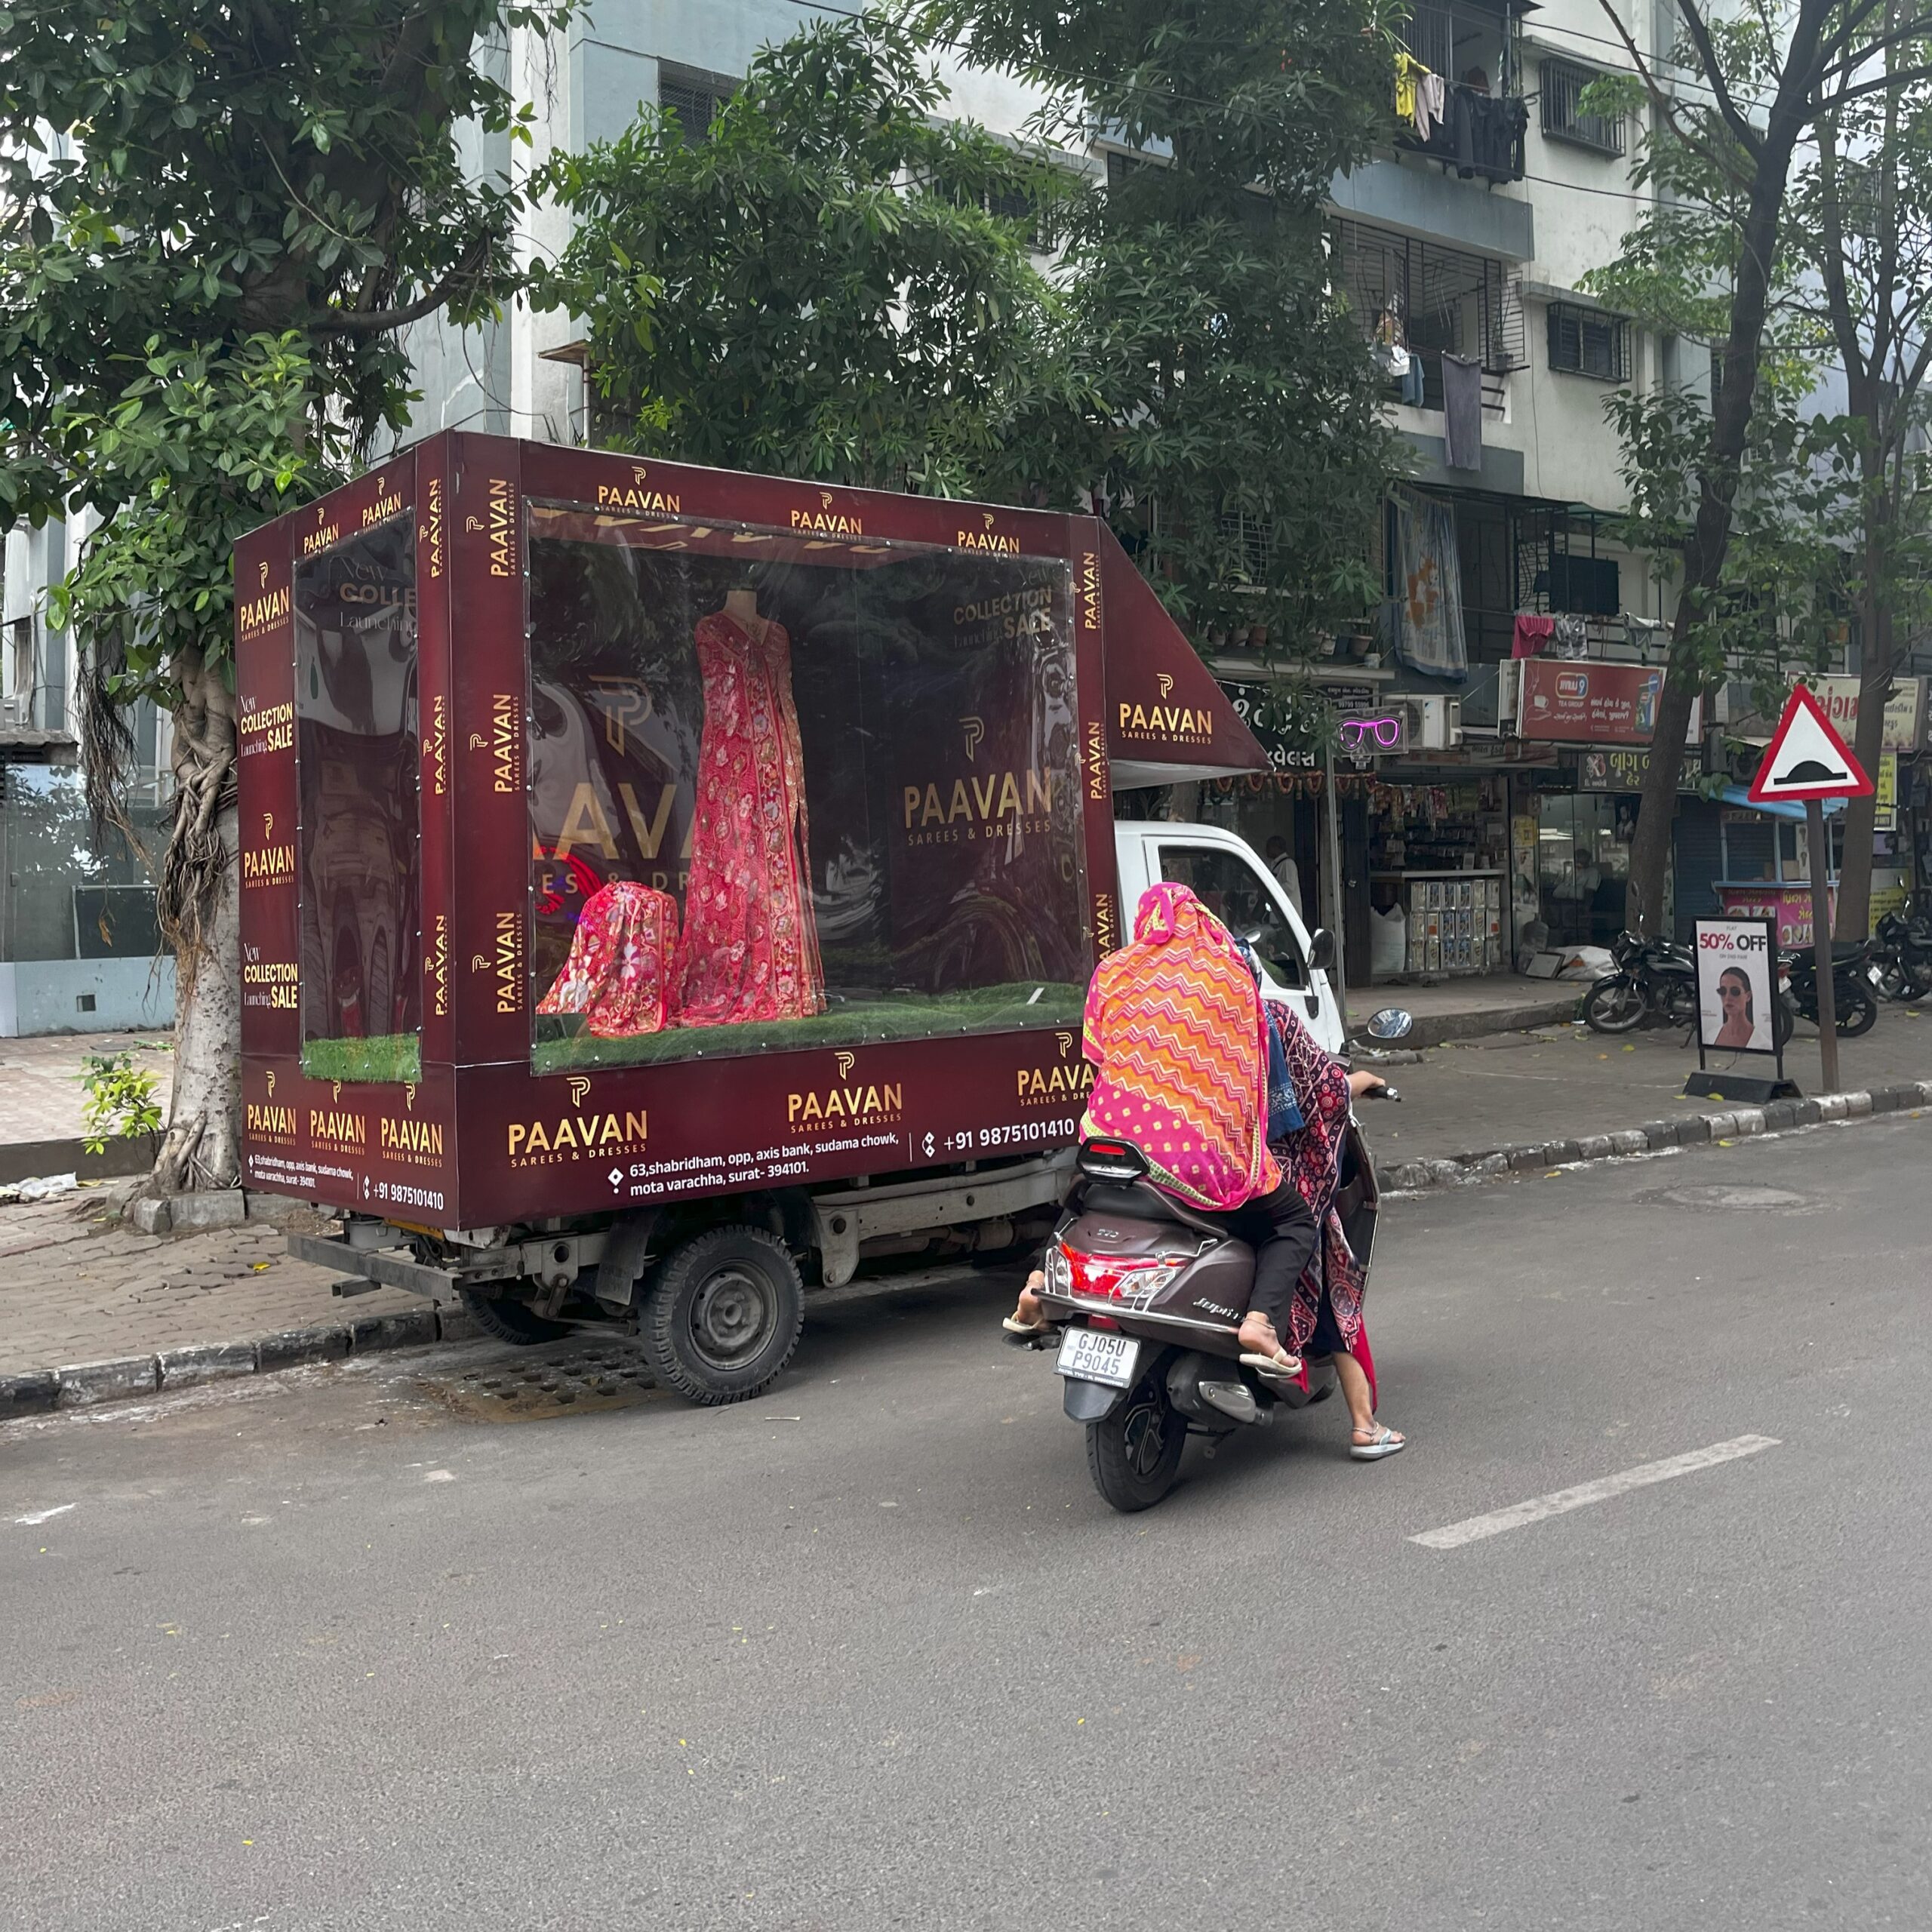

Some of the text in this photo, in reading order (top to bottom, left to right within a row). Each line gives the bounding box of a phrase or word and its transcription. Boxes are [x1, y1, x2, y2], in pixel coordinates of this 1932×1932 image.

[362, 492, 401, 527] PAAVAN
[598, 485, 679, 512] PAAVAN
[304, 522, 339, 554] PAAVAN
[429, 479, 439, 578] PAAVAN
[489, 479, 509, 577] PAAVAN
[791, 510, 862, 534] PAAVAN
[958, 531, 1019, 553] PAAVAN
[954, 585, 1052, 625] COLLECTION
[1083, 552, 1096, 629] PAAVAN
[241, 586, 289, 632] PAAVAN
[1559, 680, 1584, 694] JIVRAJ 9
[242, 701, 293, 734] COLLECTION
[1120, 703, 1212, 735] PAAVAN
[267, 724, 293, 752] SALE
[434, 696, 443, 795] PAAVAN
[494, 694, 512, 792] PAAVAN
[1122, 731, 1156, 740] SAREES
[1173, 734, 1211, 745] DRESSES
[1088, 721, 1102, 799] PAAVAN
[904, 767, 1051, 829] PAAVAN
[908, 820, 1051, 846] SAREES & DRESSES
[245, 844, 294, 878] PAAVAN
[1700, 933, 1766, 951] 50% OFF
[245, 964, 297, 983] COLLECTION
[436, 915, 445, 1015] PAAVAN
[497, 913, 515, 1013] PAAVAN
[271, 986, 297, 1008] SALE
[1017, 1063, 1095, 1096] PAAVA
[788, 1083, 903, 1122] PAAVAN
[1020, 1095, 1055, 1106] SAREES
[1073, 1091, 1090, 1100] DRE
[248, 1104, 296, 1134] PAAVAN
[310, 1109, 365, 1144] PAAVAN
[509, 1110, 648, 1155] PAAVAN
[790, 1113, 902, 1134] SAREES & DRESSES
[944, 1118, 1075, 1152] +91 9875101410
[311, 1140, 331, 1150] SAREES
[340, 1144, 365, 1155] DRESSES
[381, 1118, 442, 1155] PAAVAN
[318, 1164, 337, 1176] sudama
[383, 1151, 405, 1161] SAREES
[415, 1155, 441, 1168] DRESSES
[511, 1143, 647, 1168] SAREES & DRESSES
[629, 1132, 899, 1177] 63,shabridham, opp, axis bank, sudama chowk,
[630, 1161, 809, 1196] mota varachha, surat- 394101.
[374, 1182, 443, 1211] +91 9875101410
[1078, 1333, 1126, 1357] GJ05U
[1072, 1350, 1121, 1375] P9045
